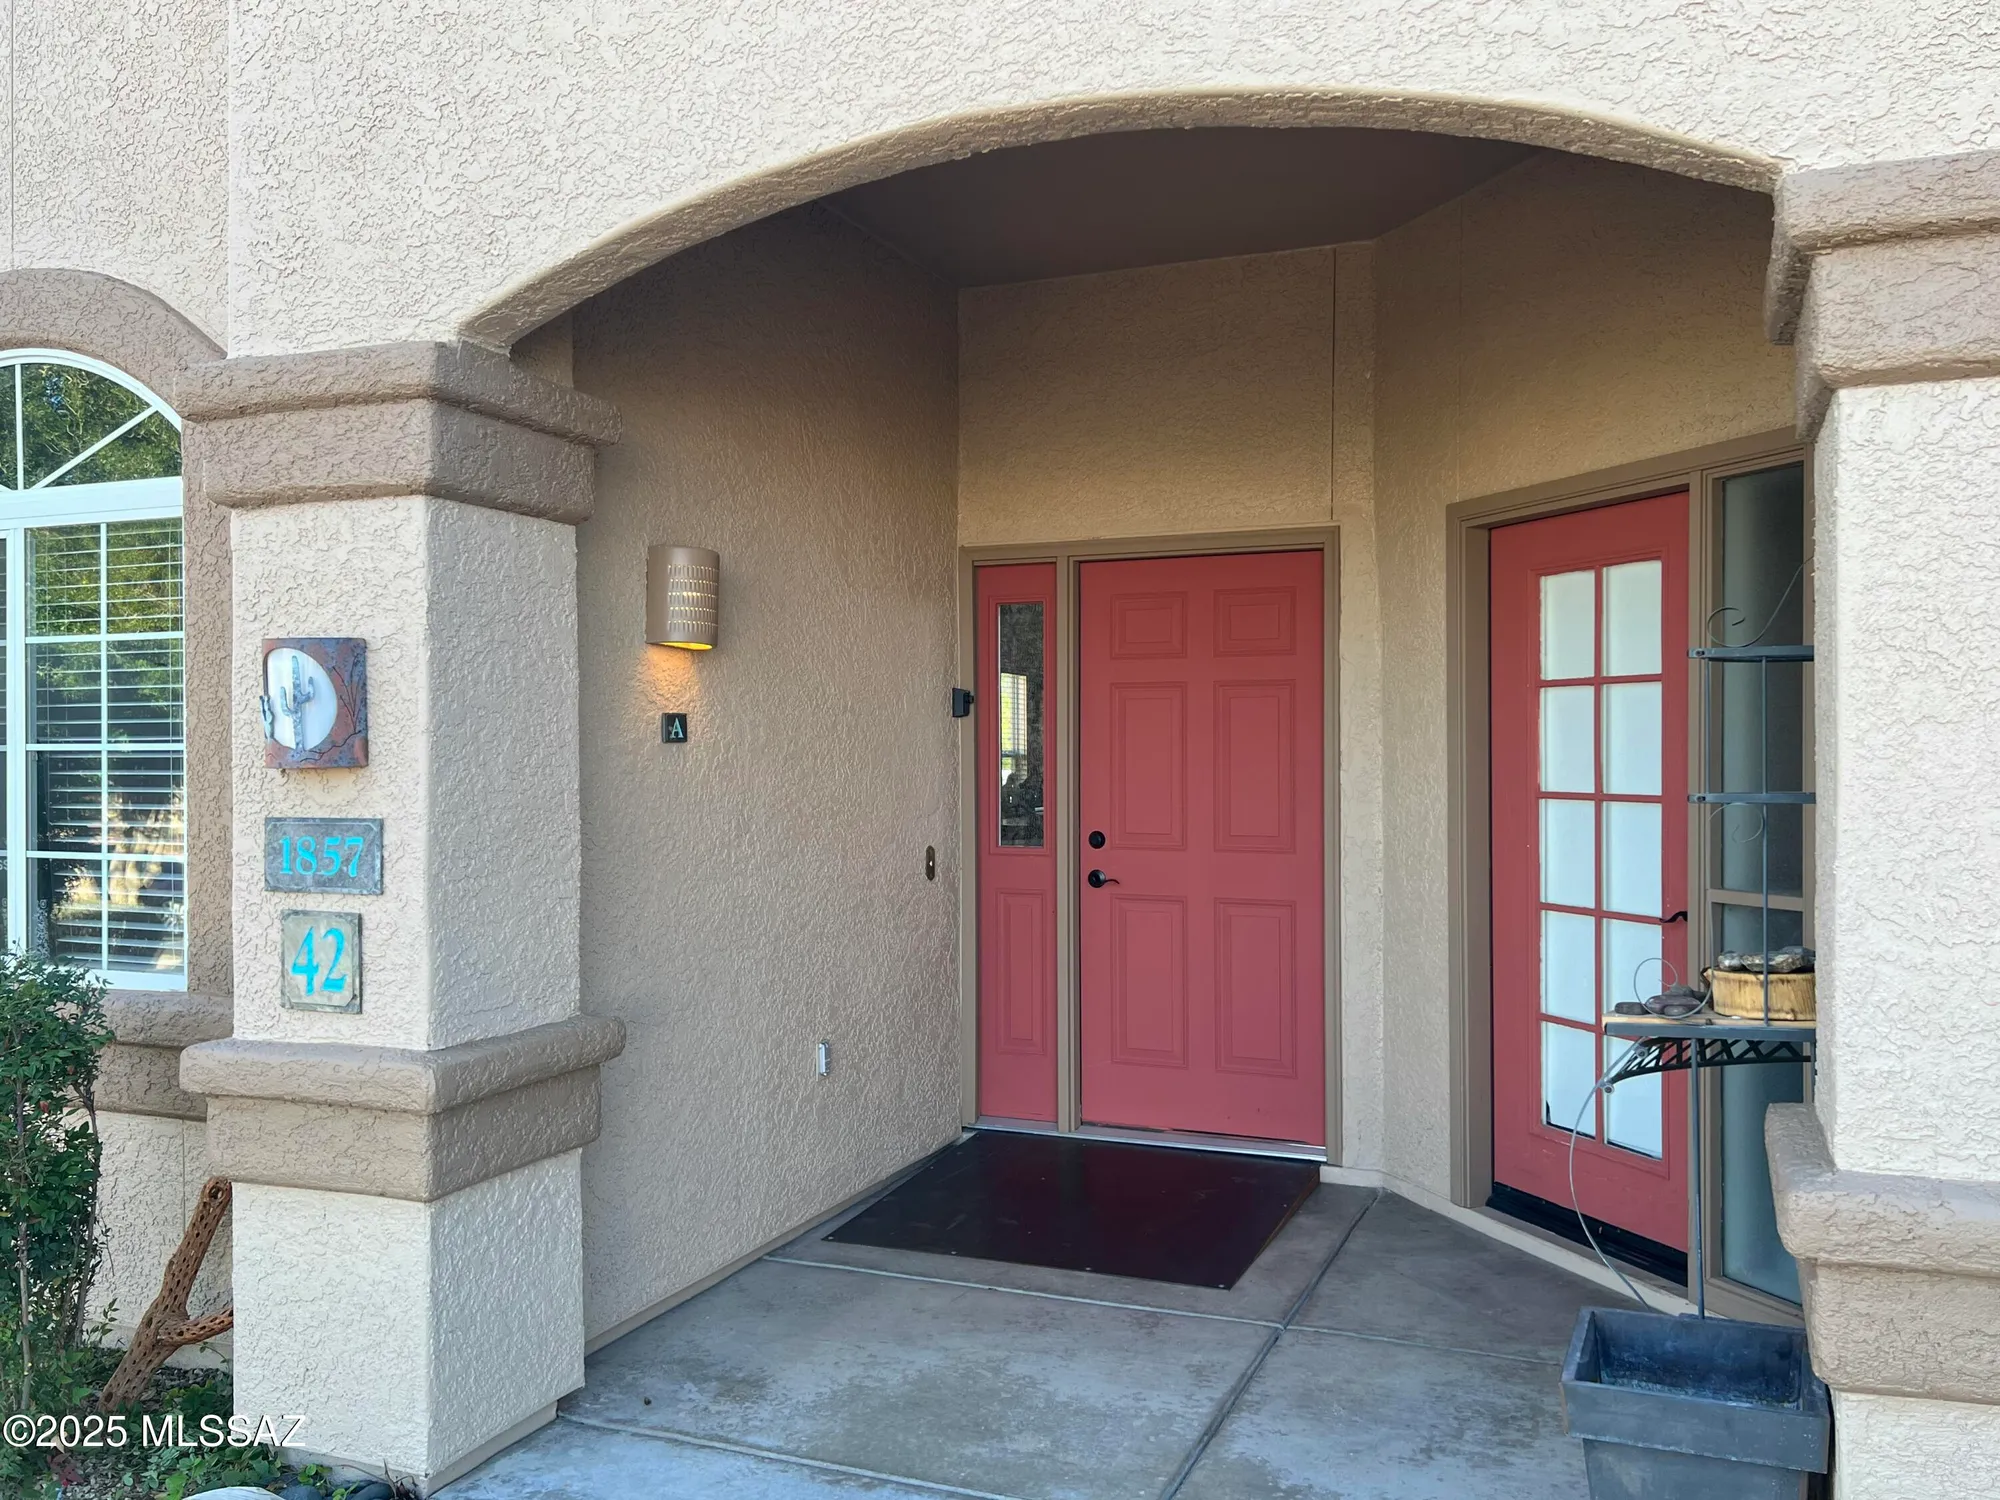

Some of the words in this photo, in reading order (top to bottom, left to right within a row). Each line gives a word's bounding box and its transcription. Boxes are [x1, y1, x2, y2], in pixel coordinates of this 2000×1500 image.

[669, 717, 684, 738] A
[280, 836, 364, 877] 1857
[291, 926, 347, 996] 42
